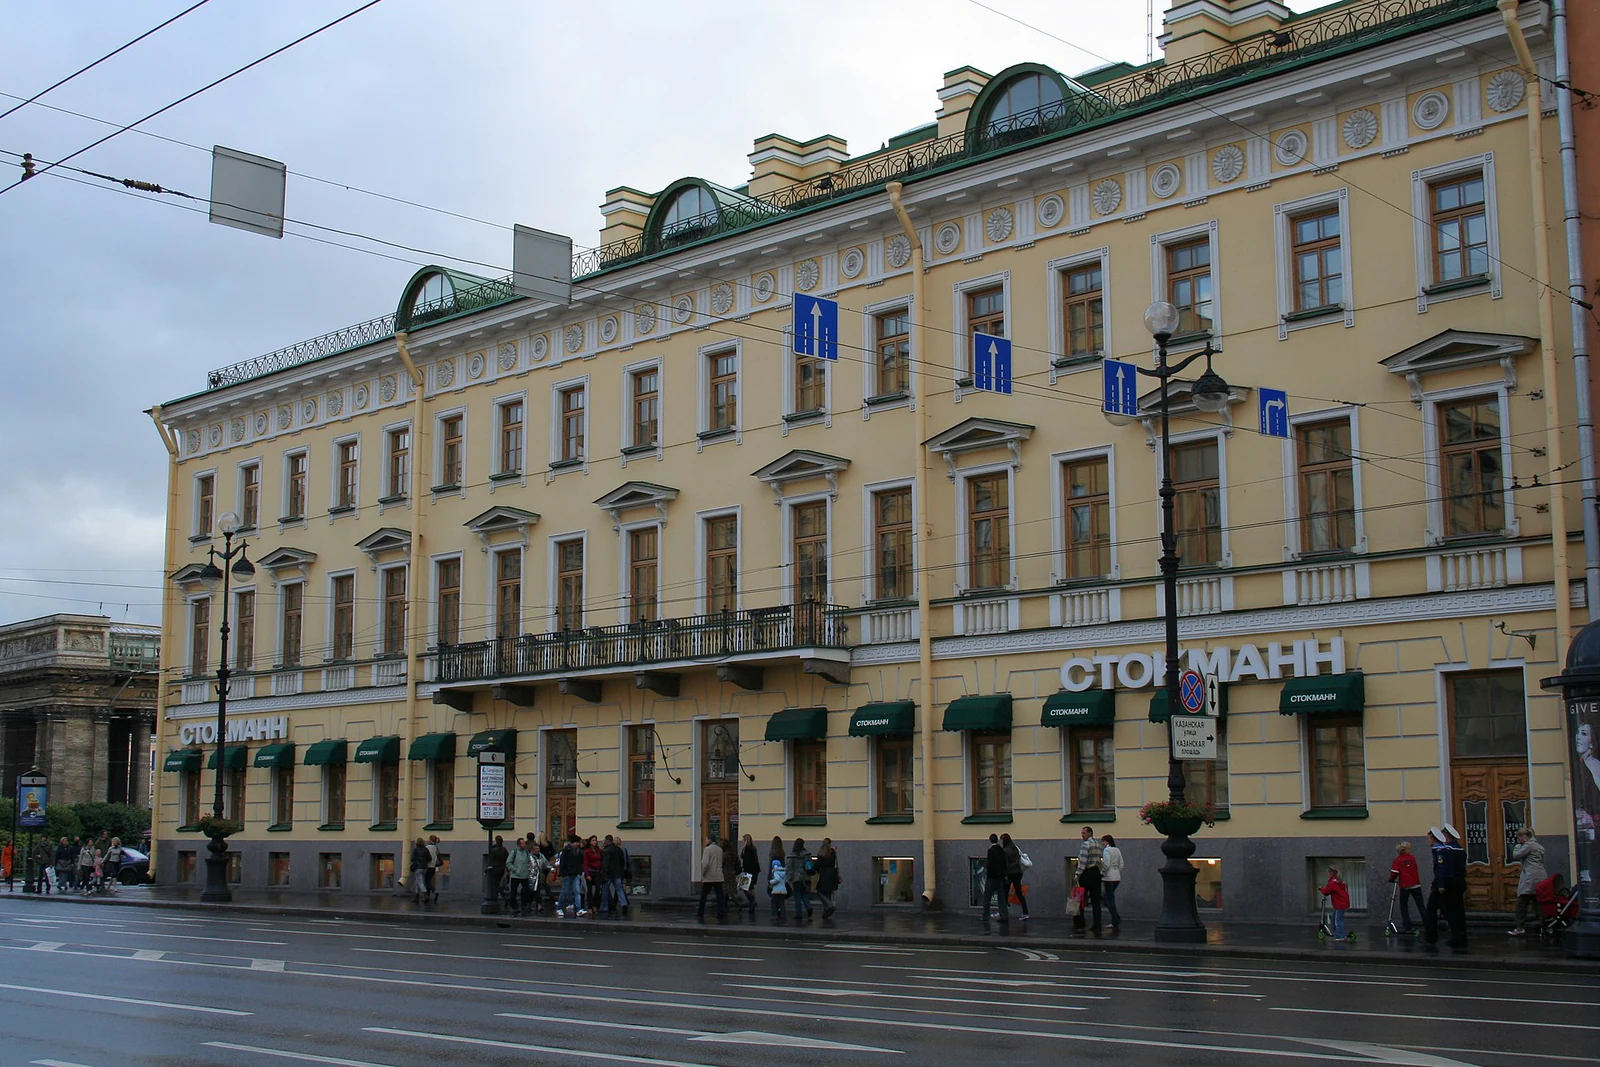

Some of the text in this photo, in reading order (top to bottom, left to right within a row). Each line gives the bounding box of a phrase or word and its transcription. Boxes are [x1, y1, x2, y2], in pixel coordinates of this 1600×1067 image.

[1290, 693, 1336, 702] СТОКМАНН
[1050, 708, 1088, 716] СТОКМАНН
[1570, 703, 1598, 714] GIVE
[856, 719, 889, 727] СТОКМАНН
